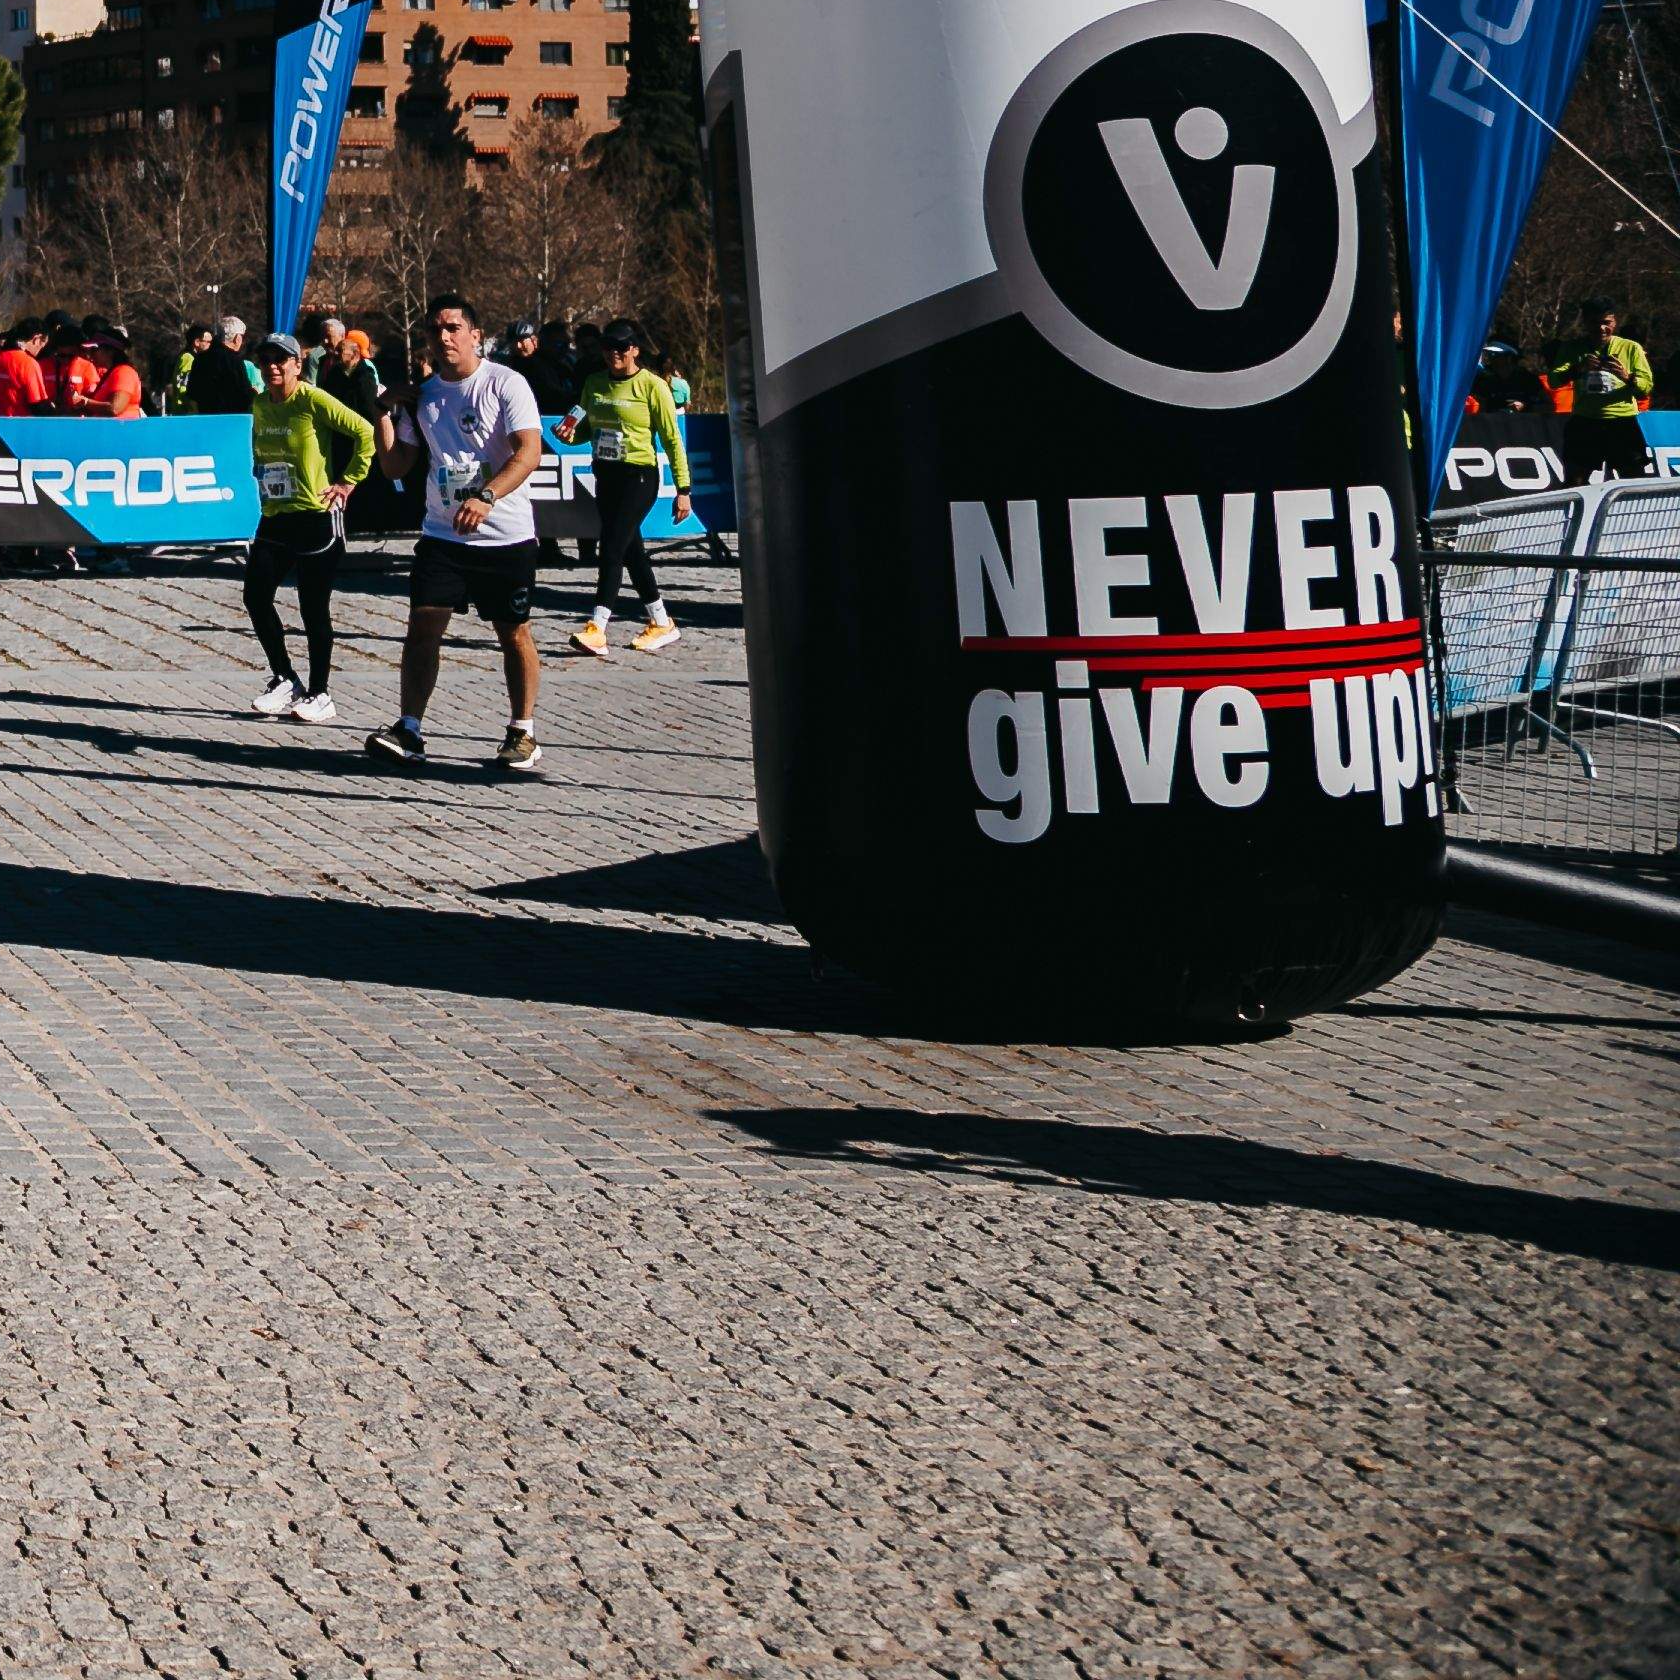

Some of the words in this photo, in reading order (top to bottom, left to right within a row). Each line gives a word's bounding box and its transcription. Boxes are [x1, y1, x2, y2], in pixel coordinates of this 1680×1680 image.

[949, 486, 1402, 637] NEVER
[967, 661, 1270, 844] give
[1310, 664, 1440, 827] up!
